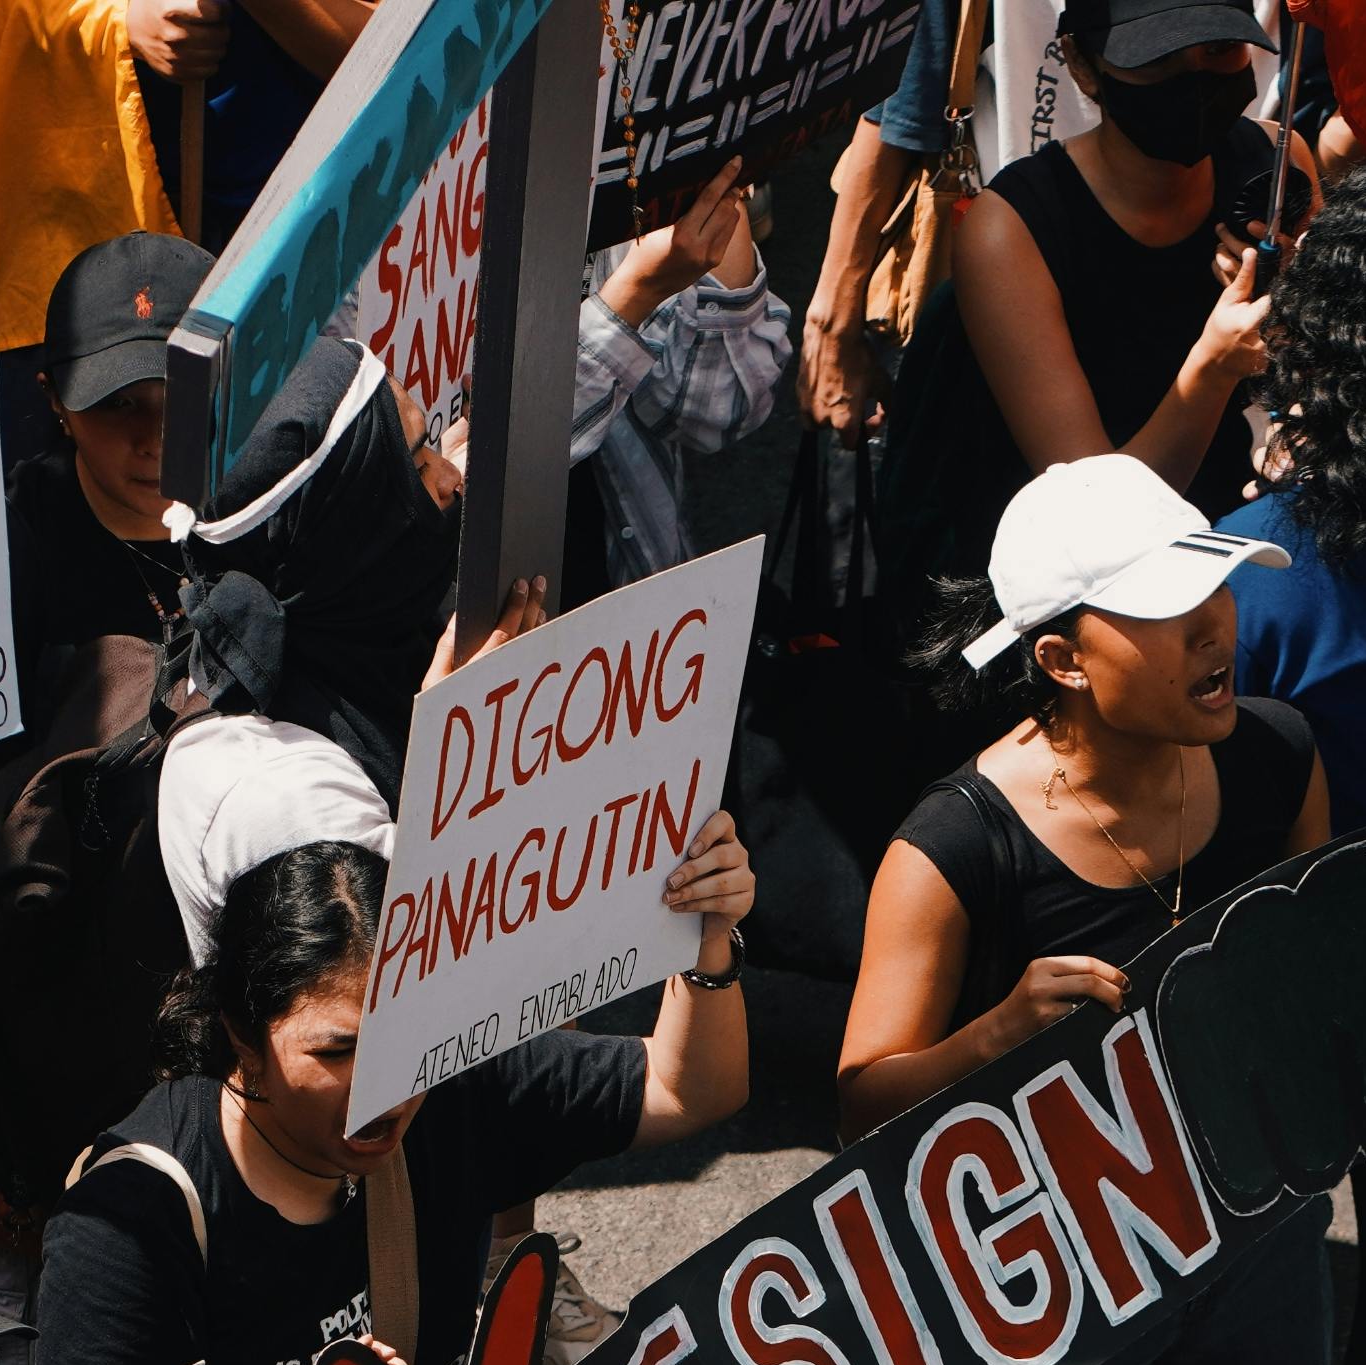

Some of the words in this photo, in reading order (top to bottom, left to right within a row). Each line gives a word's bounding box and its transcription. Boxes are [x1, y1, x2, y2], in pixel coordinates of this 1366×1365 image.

[1031, 66, 1060, 154] IRST
[431, 609, 708, 840] DIGONG
[369, 758, 702, 1013] PANAGUTIN
[411, 1012, 501, 1095] ATENEO
[517, 947, 639, 1039] ENTABLADO
